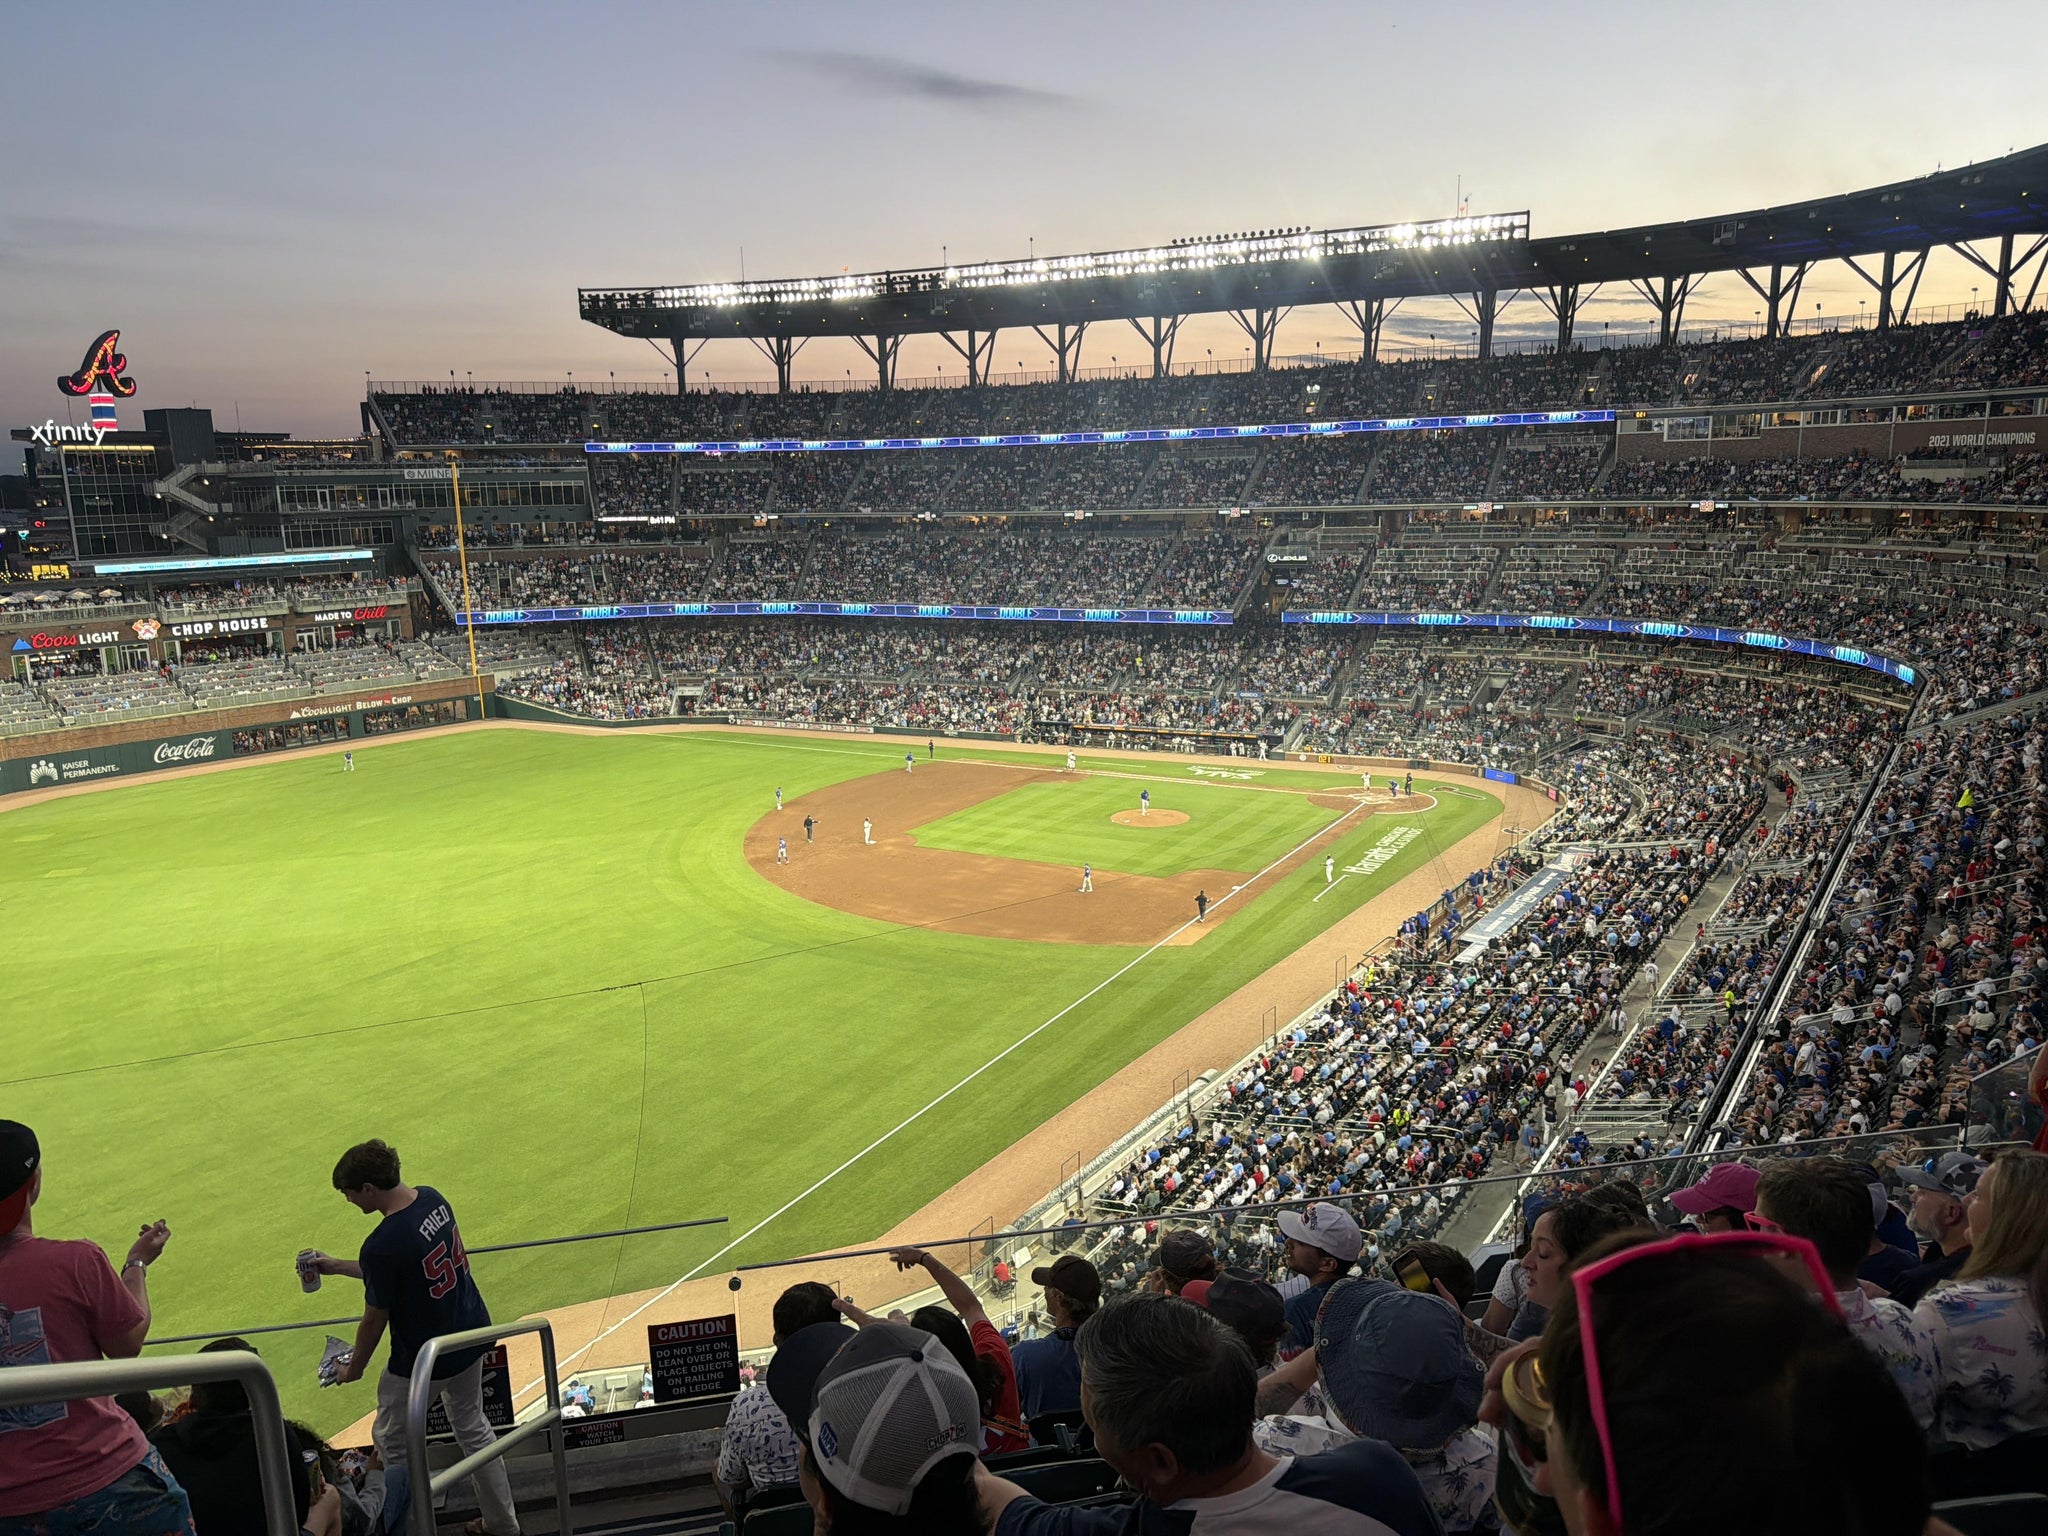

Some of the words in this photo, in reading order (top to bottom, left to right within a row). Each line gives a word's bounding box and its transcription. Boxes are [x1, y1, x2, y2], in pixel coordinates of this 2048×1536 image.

[1466, 415, 1495, 425] DOUBLE
[1549, 411, 1580, 421] DOUBLE
[30, 419, 106, 446] xfinity
[1928, 435, 1950, 447] 2021
[1952, 434, 1985, 446] WORLD
[1986, 432, 2036, 445] CHAMPIONS
[417, 470, 455, 479] MILNE
[315, 612, 339, 621] MADE
[341, 611, 352, 620] TO
[354, 605, 387, 620] Chill
[582, 607, 620, 619] DOUBLE
[675, 604, 710, 615] DOUBLE
[762, 603, 797, 614] DOUBLE
[842, 604, 874, 615] DOUBLE
[918, 606, 951, 617] DOUBLE
[1000, 607, 1033, 618] DOUBLE
[1085, 609, 1121, 620] DOUBLE
[485, 610, 525, 623] DOUBLE
[1175, 610, 1213, 622] DOUBLE
[172, 622, 213, 636] CHOP
[219, 618, 269, 632] HOUSE
[31, 632, 77, 649] Coors
[79, 631, 119, 645] LIGHT
[328, 704, 353, 713] LIGHT
[154, 736, 217, 763] Coca-Cola
[62, 760, 90, 770] KAISER
[63, 764, 117, 779] PERMANENTE
[419, 1204, 450, 1242] FRIED
[422, 1222, 470, 1299] 54
[657, 1320, 727, 1341] CAUTION
[656, 1350, 671, 1358] DO
[673, 1346, 693, 1356] NOT
[695, 1343, 711, 1352] SIT
[658, 1358, 684, 1368] LEAN
[687, 1353, 713, 1364] OVER
[716, 1351, 730, 1360] OR
[657, 1367, 688, 1378] PLACE
[691, 1360, 734, 1373] OBJECTS
[667, 1377, 682, 1386] ON
[685, 1371, 724, 1384] RAILING
[672, 1386, 687, 1395] OR
[689, 1382, 721, 1393] LEDGE
[581, 1421, 618, 1433] CAUTION
[579, 1437, 601, 1447] YOUR
[603, 1434, 624, 1443] STEP
[586, 1429, 615, 1439] WATCH
[927, 1430, 950, 1449] CHOP
